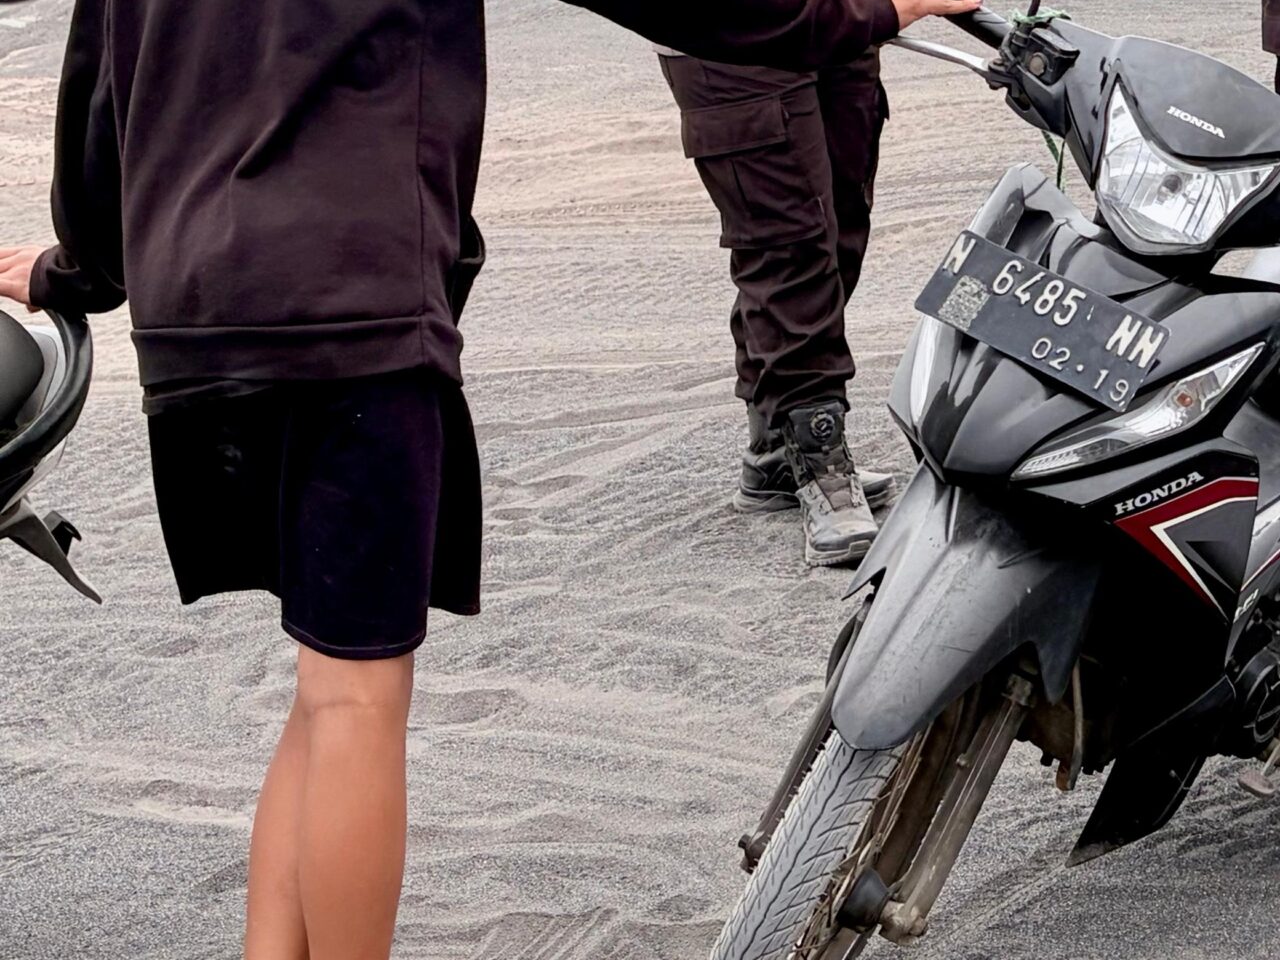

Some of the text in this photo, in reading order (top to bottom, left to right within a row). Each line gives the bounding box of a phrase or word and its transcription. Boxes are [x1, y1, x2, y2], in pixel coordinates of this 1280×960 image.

[1166, 105, 1226, 139] HONDA
[942, 233, 1165, 369] N 6485 NN
[1113, 471, 1205, 516] HONDA
